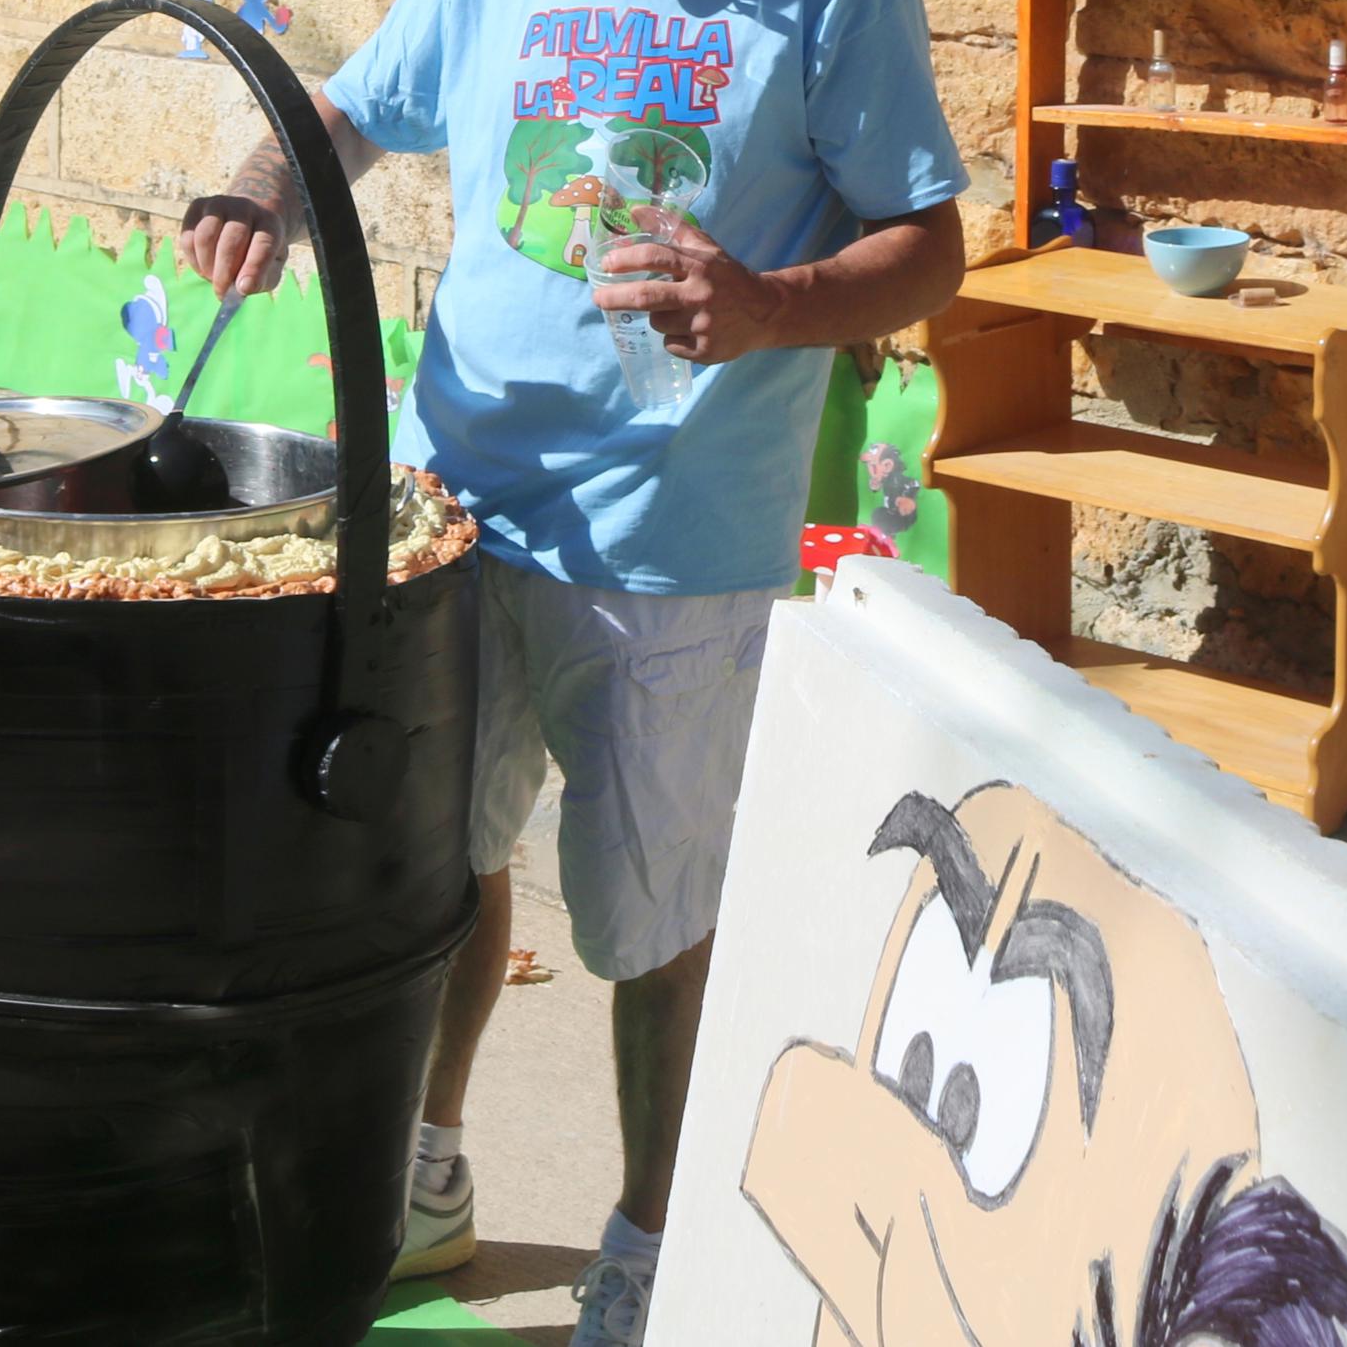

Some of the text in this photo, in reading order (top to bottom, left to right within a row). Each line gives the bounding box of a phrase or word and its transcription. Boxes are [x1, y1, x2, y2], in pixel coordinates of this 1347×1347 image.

[520, 7, 733, 67] PITUVILLA
[514, 54, 720, 126] LA REAL
